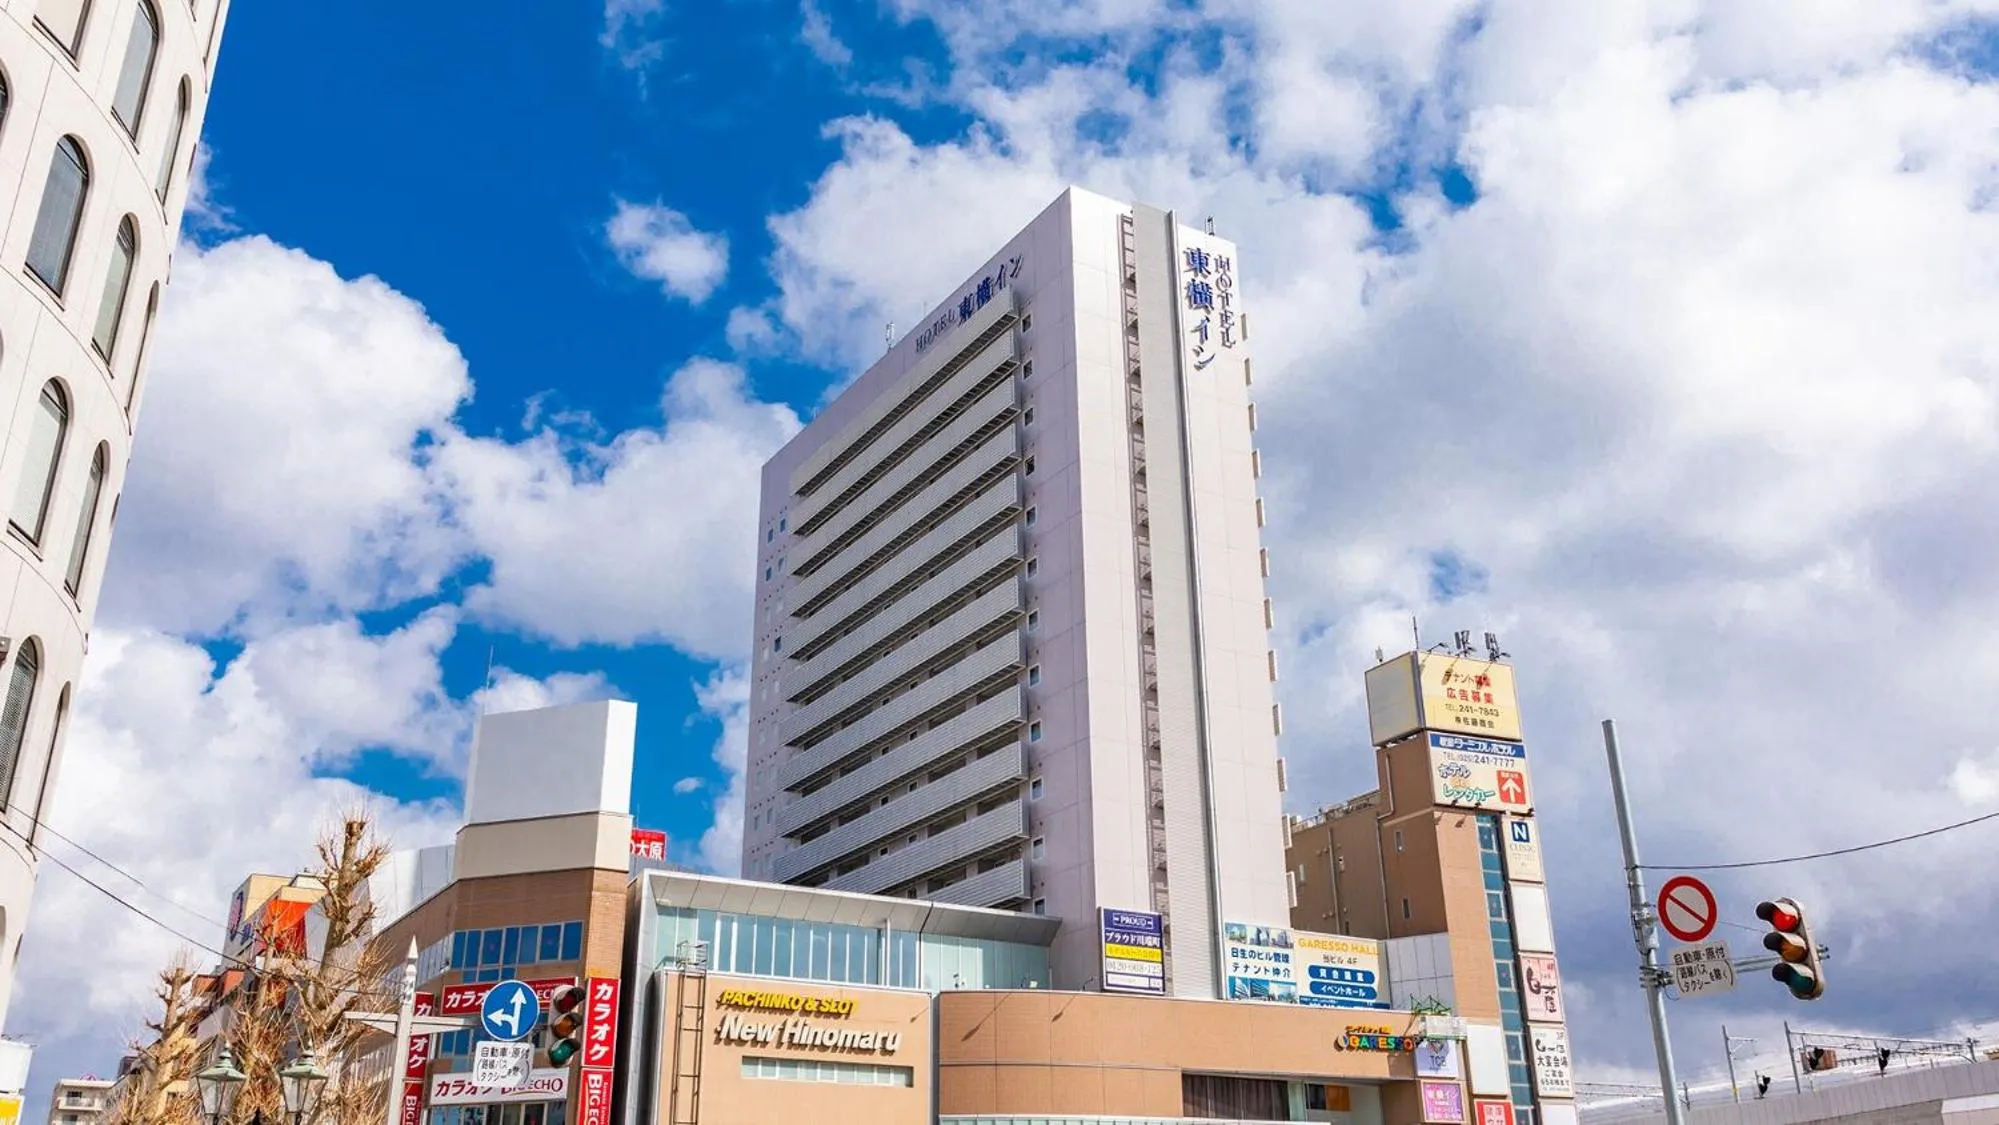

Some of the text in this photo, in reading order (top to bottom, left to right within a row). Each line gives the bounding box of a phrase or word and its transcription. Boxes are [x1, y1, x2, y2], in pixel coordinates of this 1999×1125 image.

[915, 253, 1024, 353] HOTEL 東横イン
[1183, 247, 1215, 372] 東横イン
[1214, 253, 1237, 350] HOTEL
[1447, 686, 1495, 705] 広告募集
[1438, 761, 1472, 779] ホテル
[1442, 782, 1497, 802] レンタカー
[1512, 823, 1528, 841] N
[1120, 915, 1148, 926] PROUD
[1298, 938, 1376, 954] GARESSO HALL
[1231, 947, 1290, 964] 日生のビル管理
[1673, 947, 1725, 965] 自動車・原付
[1232, 962, 1291, 978] テナント仲介
[1321, 985, 1366, 997] イベントホール
[721, 988, 860, 1013] PACHINKO & SLOT
[589, 984, 614, 1062] カラオケ
[720, 1014, 902, 1051] New Hinomaru
[481, 1047, 530, 1059] 自動車・原付
